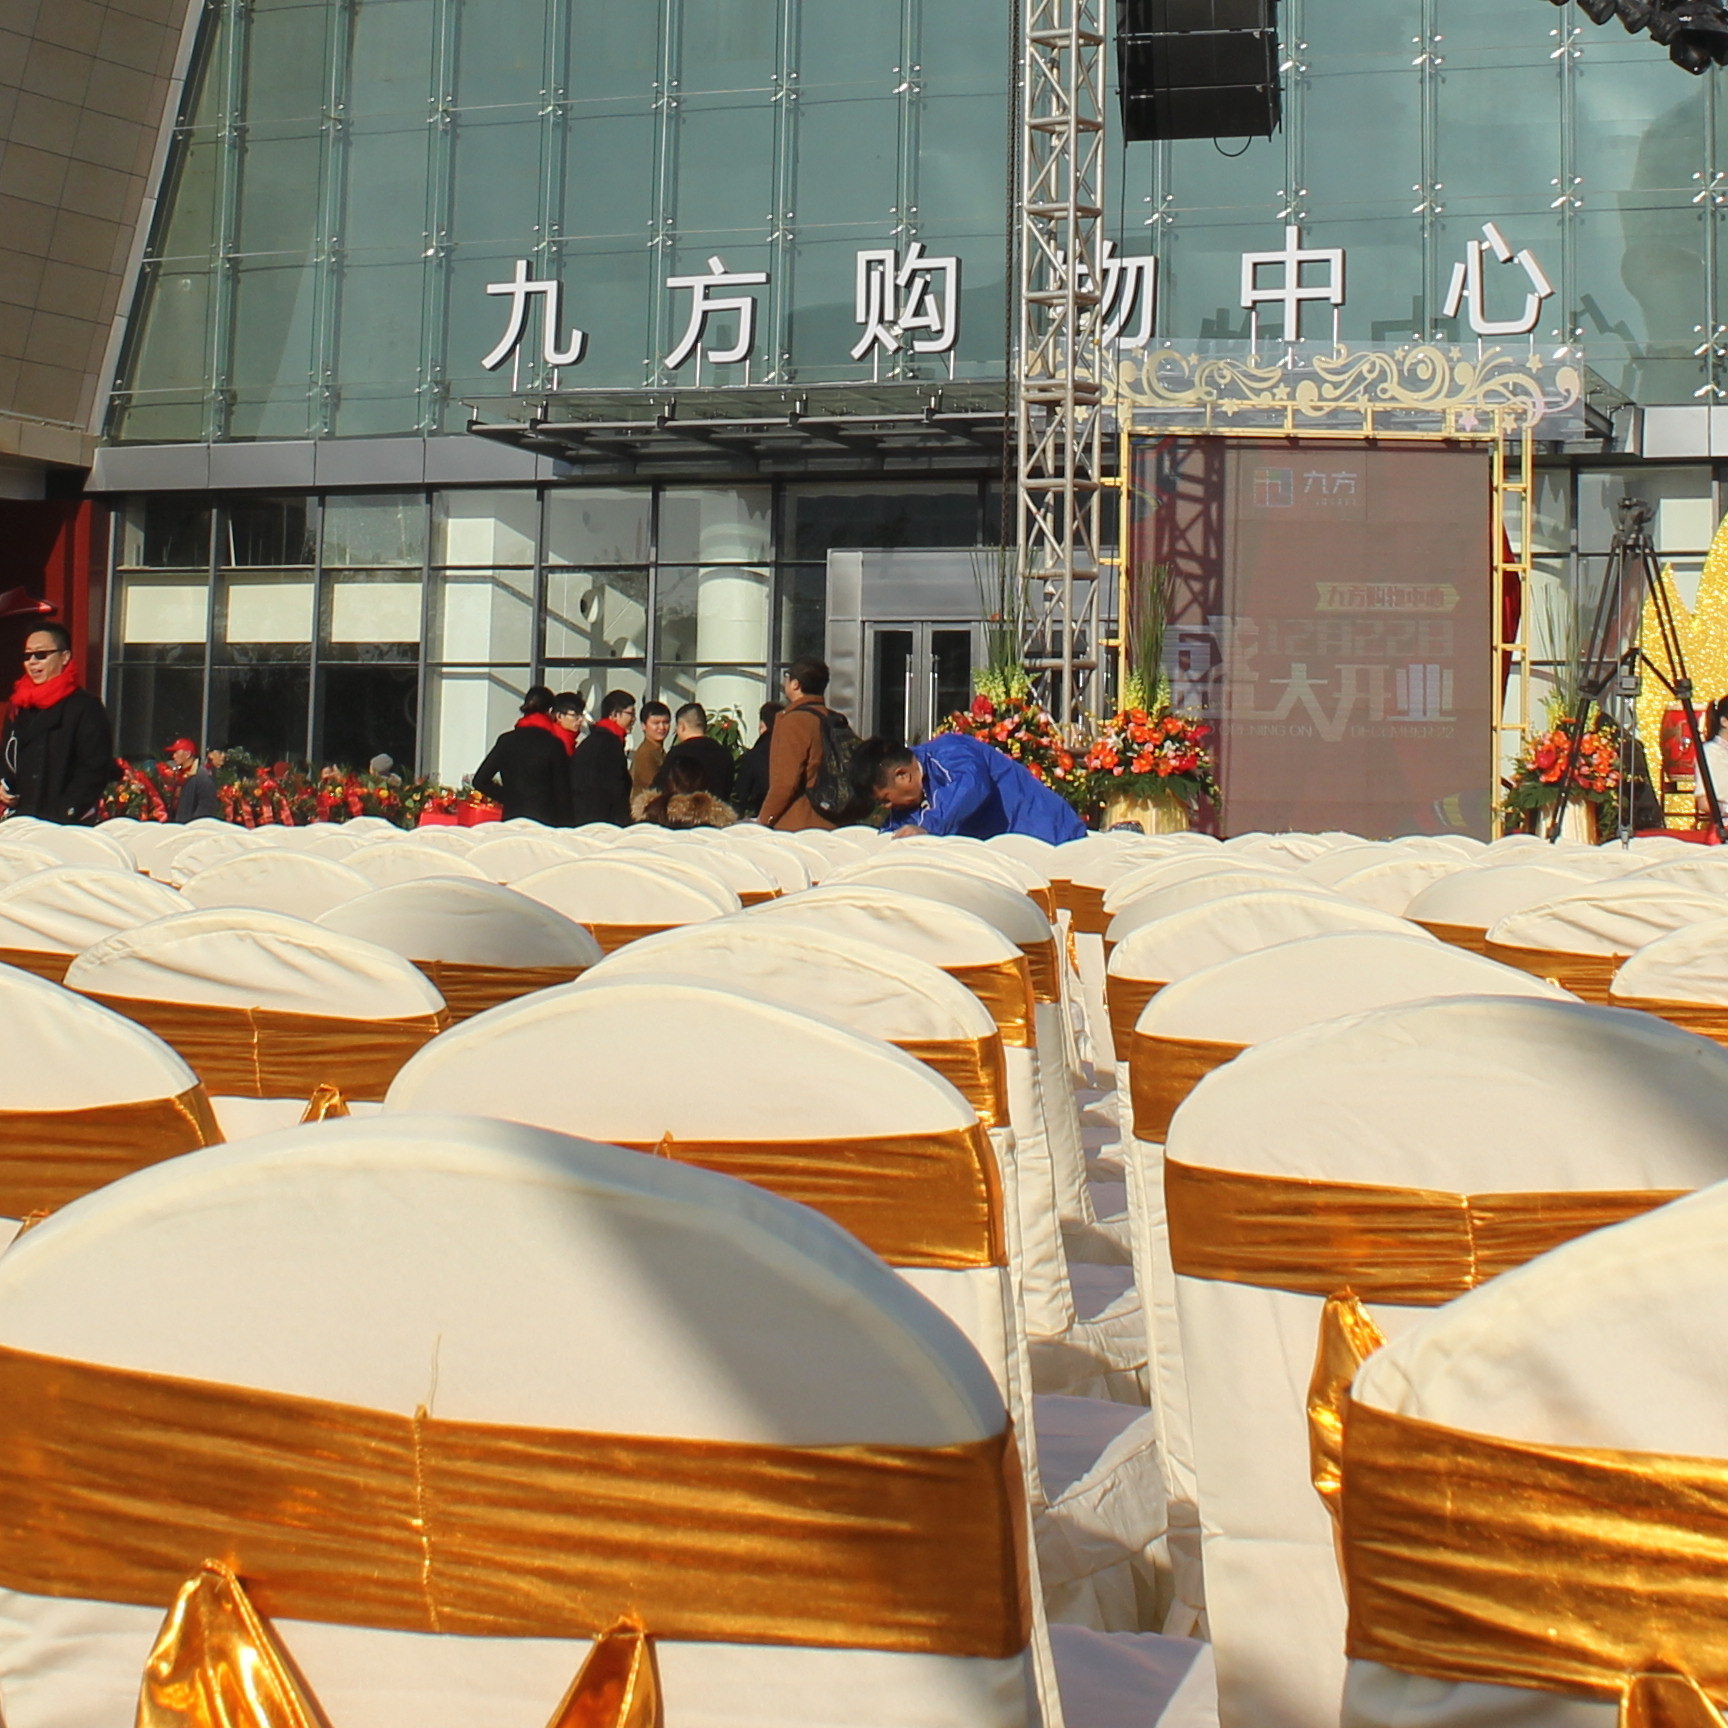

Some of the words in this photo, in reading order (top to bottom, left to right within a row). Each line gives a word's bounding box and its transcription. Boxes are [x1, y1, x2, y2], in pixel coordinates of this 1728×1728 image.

[480, 221, 1552, 371] 九方购物中心
[1303, 470, 1358, 495] 九方
